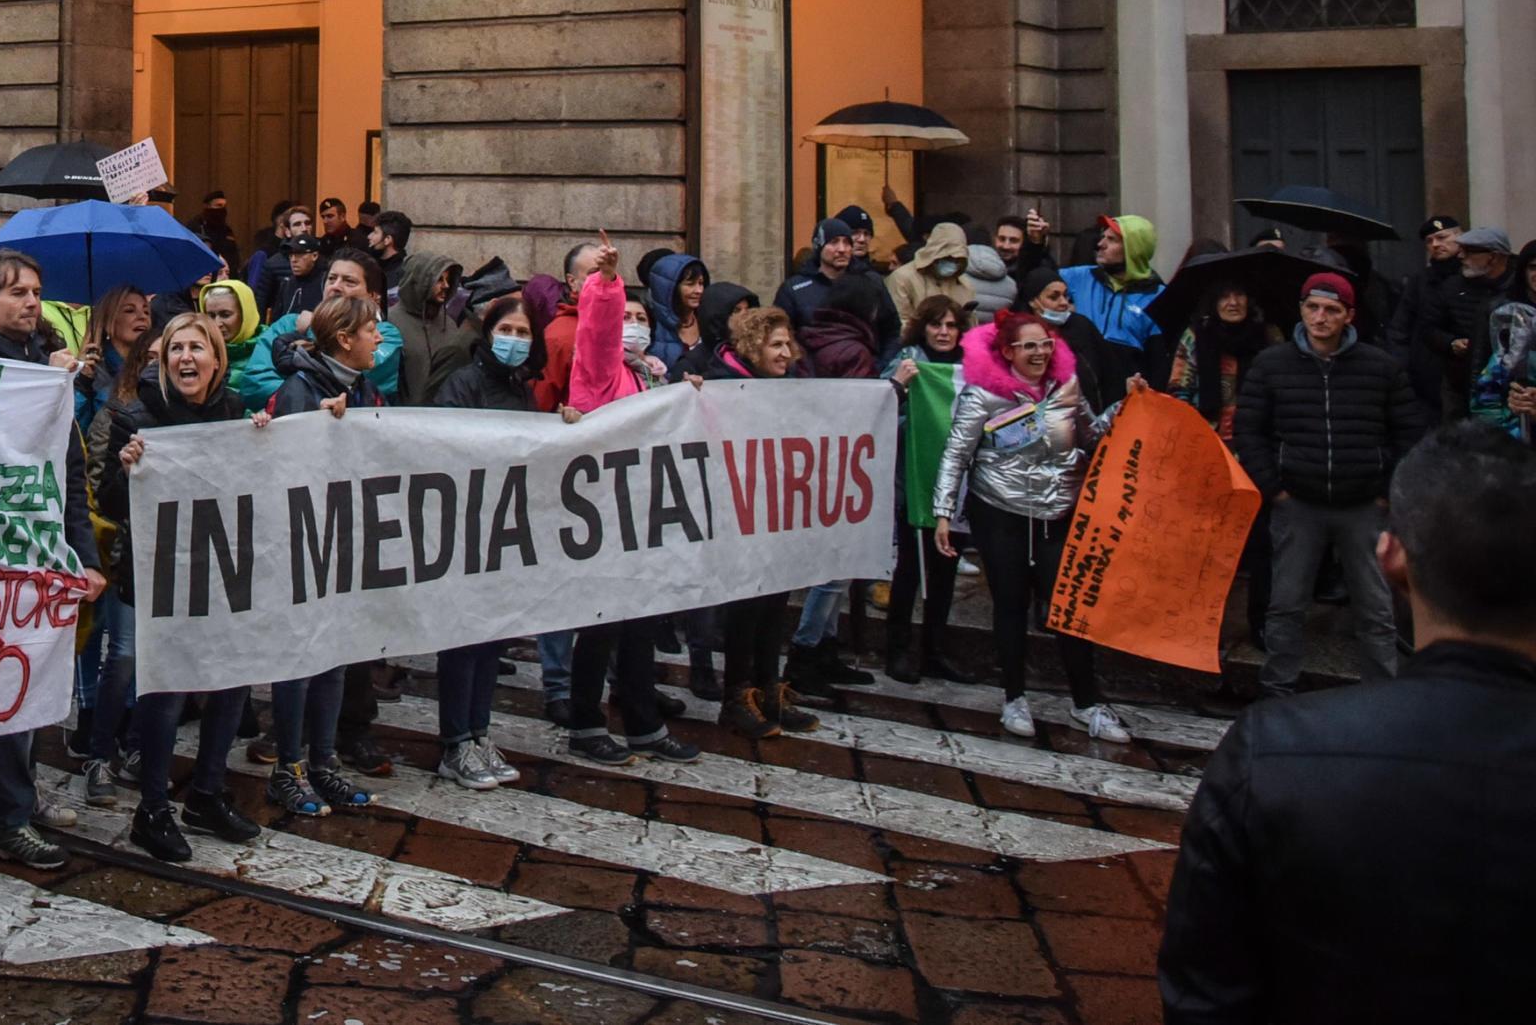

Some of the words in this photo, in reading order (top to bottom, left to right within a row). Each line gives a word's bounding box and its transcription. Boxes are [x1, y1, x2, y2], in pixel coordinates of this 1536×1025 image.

[151, 493, 254, 618] IN
[287, 464, 537, 606] MEDIA
[560, 441, 712, 560] STAT
[723, 433, 875, 536] VIRUS
